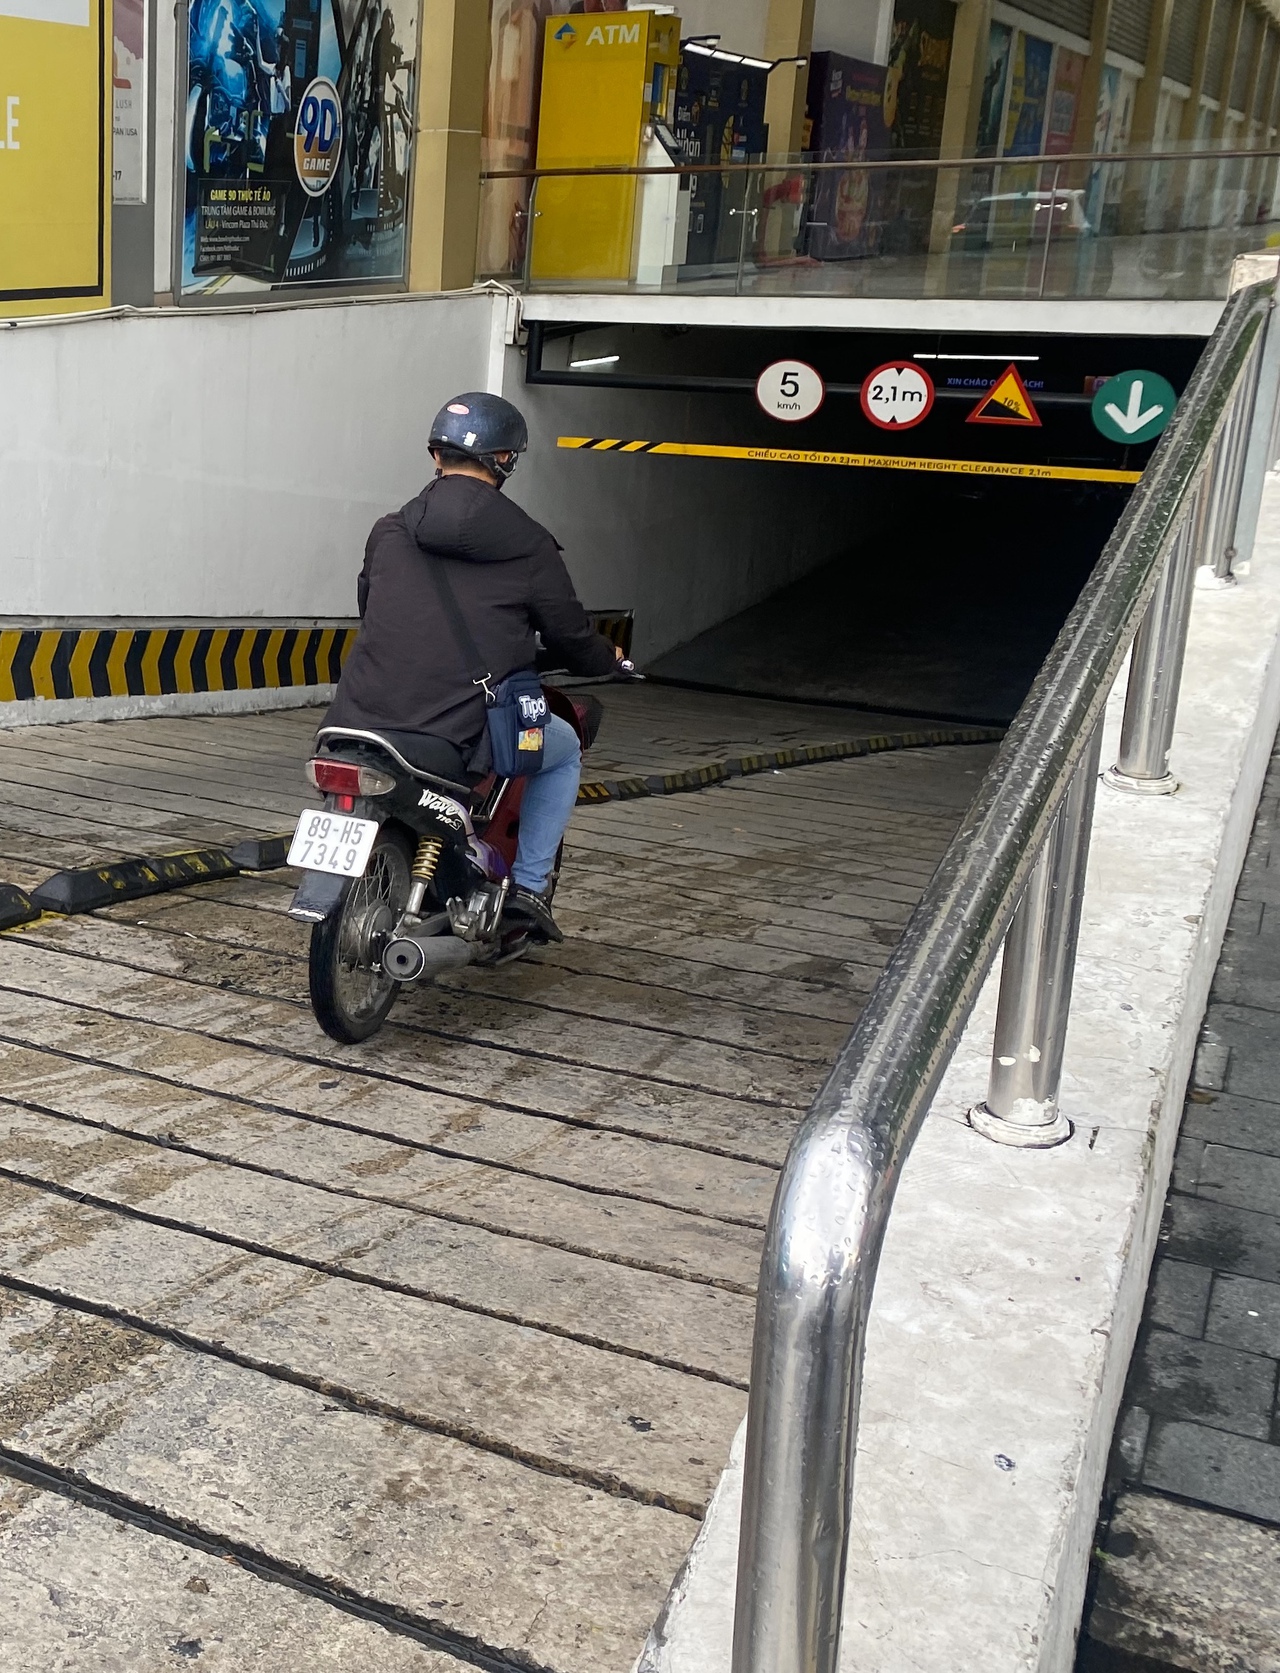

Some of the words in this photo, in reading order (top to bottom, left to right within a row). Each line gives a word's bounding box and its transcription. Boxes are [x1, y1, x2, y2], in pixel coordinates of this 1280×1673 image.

[585, 23, 640, 46] ATM
[301, 96, 338, 152] 9D
[303, 158, 331, 171] GAME
[210, 189, 228, 201] GAME
[228, 189, 237, 201] 9D
[201, 205, 220, 216] TRUNG
[232, 206, 248, 216] GAME
[252, 206, 276, 216] BOWLING
[221, 220, 239, 229] Vincom
[780, 371, 800, 398] 5
[946, 377, 962, 386] XIN
[872, 385, 923, 404] 2,1m
[1003, 396, 1020, 412] 10%
[777, 402, 801, 411] km/h
[779, 452, 801, 461] CAO
[803, 451, 820, 462] TỐI
[867, 457, 917, 468] MAXIMUM
[919, 461, 957, 471] HEIGHT
[960, 463, 1024, 475] CLEARANCE
[417, 789, 459, 816] Wave
[307, 816, 366, 845] 89-H5
[300, 840, 357, 871] 7349
